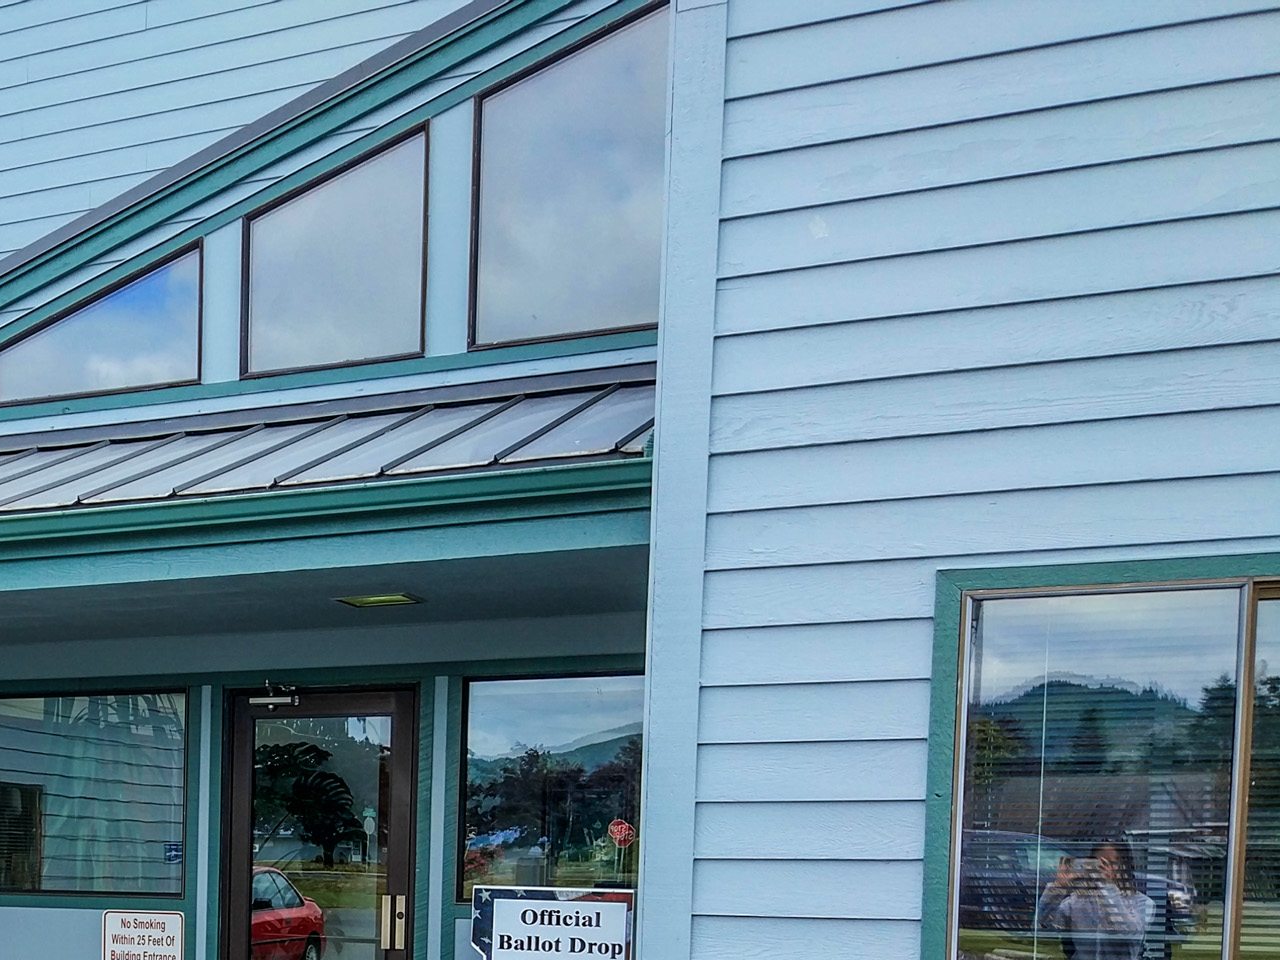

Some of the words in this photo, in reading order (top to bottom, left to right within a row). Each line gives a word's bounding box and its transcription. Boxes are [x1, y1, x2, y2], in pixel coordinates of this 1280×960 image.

[120, 918, 132, 929] No
[133, 918, 166, 932] Smoking
[520, 908, 601, 928] Official
[111, 933, 135, 945] Within
[137, 934, 146, 946] 25
[148, 935, 164, 947] Feet
[165, 935, 176, 947] Of
[498, 934, 562, 953] Ballot
[569, 937, 623, 959] Drop
